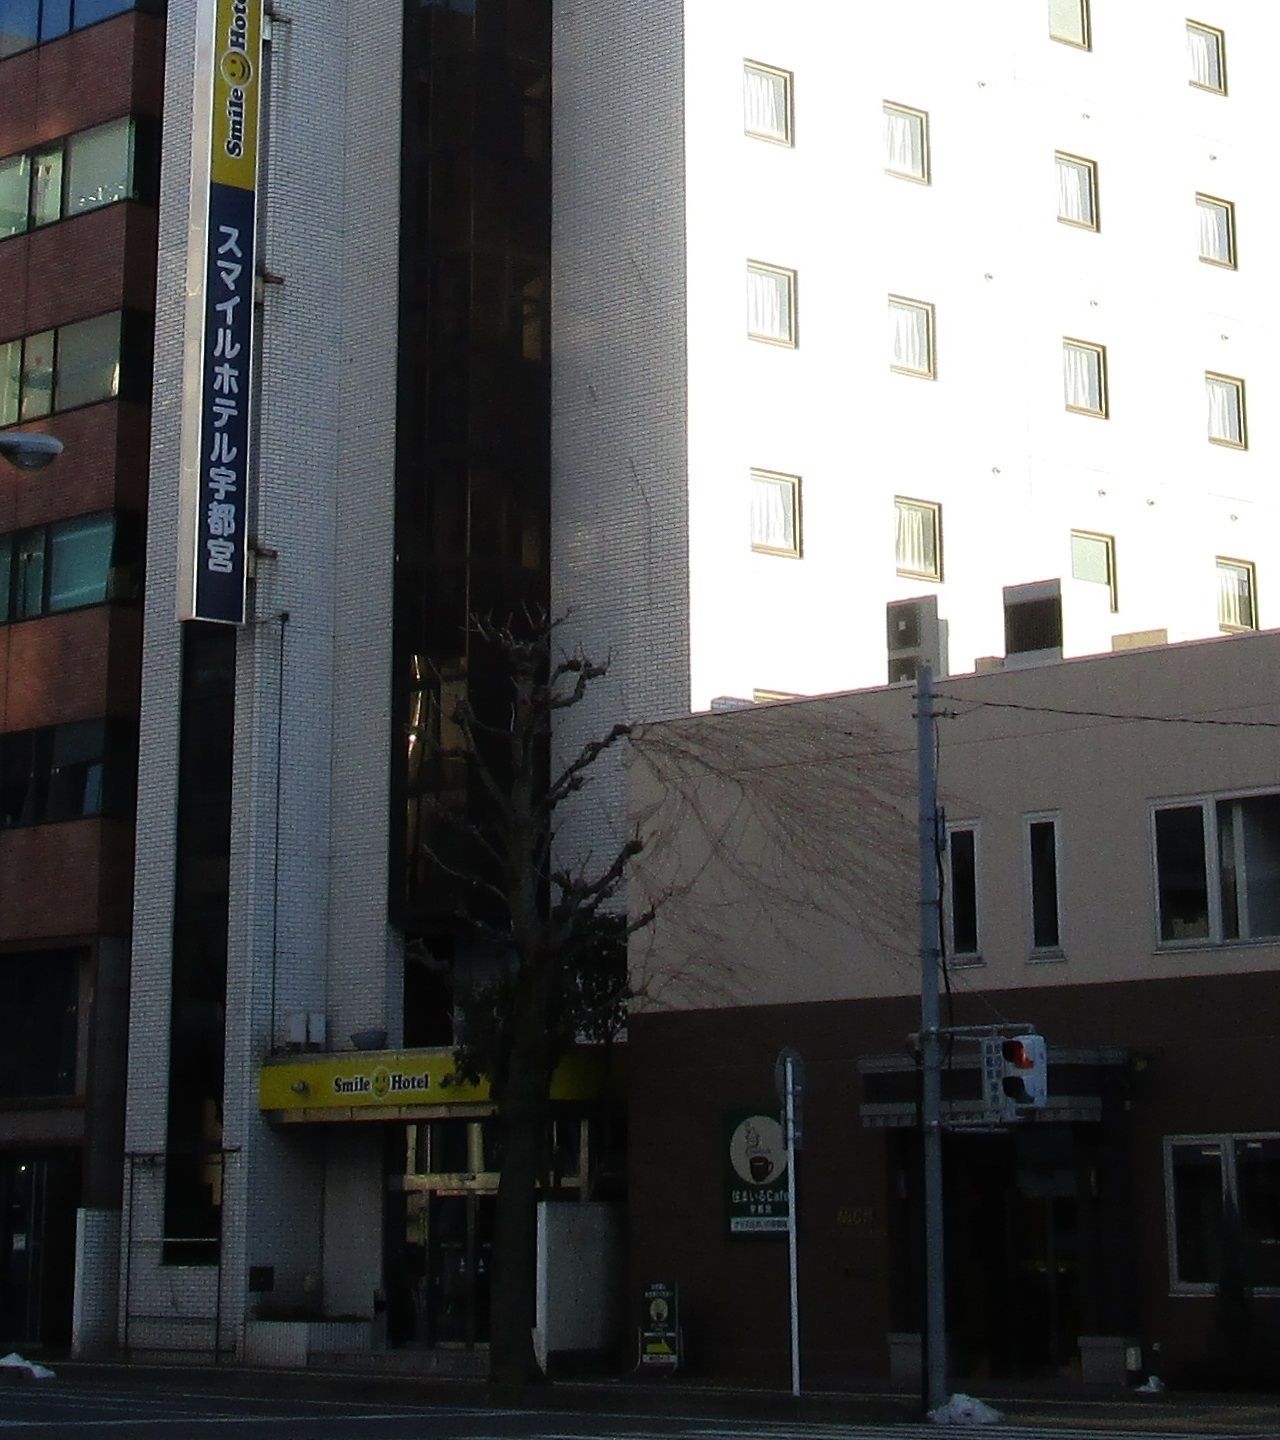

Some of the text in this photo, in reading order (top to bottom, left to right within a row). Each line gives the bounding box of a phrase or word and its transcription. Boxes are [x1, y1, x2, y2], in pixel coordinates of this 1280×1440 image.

[226, 87, 245, 158] Smile
[206, 225, 243, 574] スマイルホテル宇都宮
[334, 1073, 430, 1093] Smile Hotel
